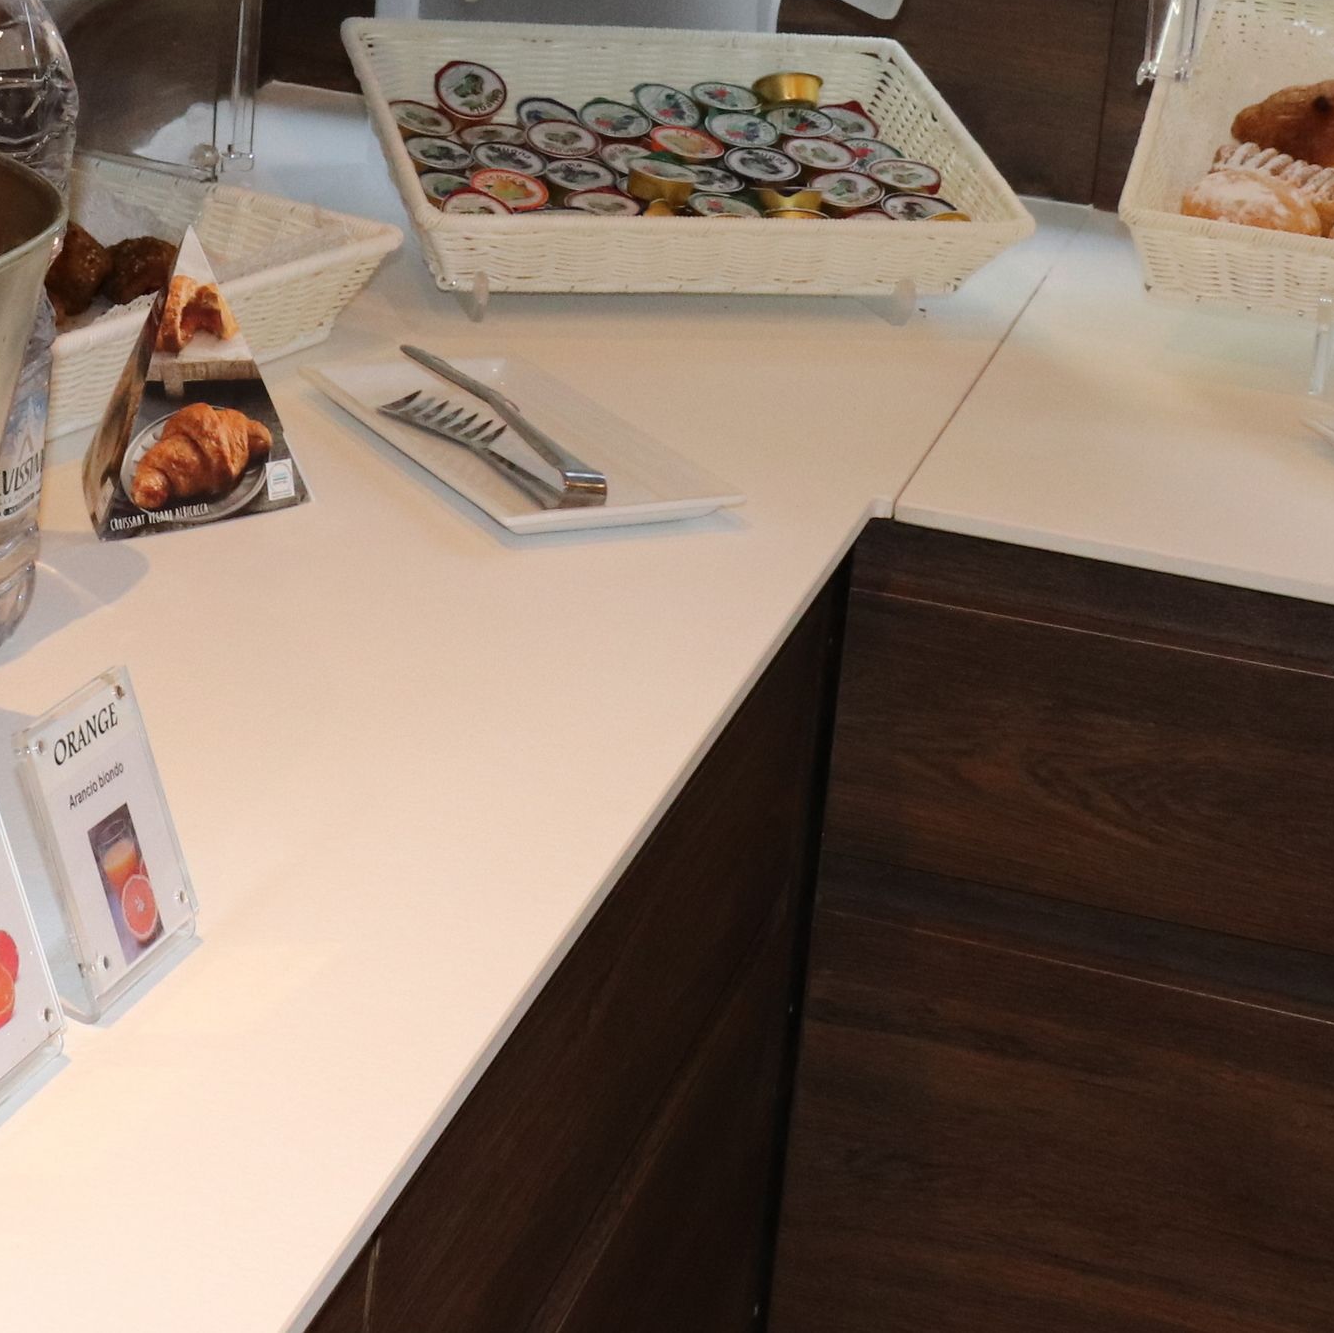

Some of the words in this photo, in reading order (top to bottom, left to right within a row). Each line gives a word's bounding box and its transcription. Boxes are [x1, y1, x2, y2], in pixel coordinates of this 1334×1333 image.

[110, 515, 145, 531] CROISSANT
[147, 509, 173, 525] VEGANO
[175, 503, 209, 520] ALBICOCCA
[53, 702, 119, 766] ORANGE
[69, 780, 98, 811] Arancio
[97, 761, 125, 789] biondo
